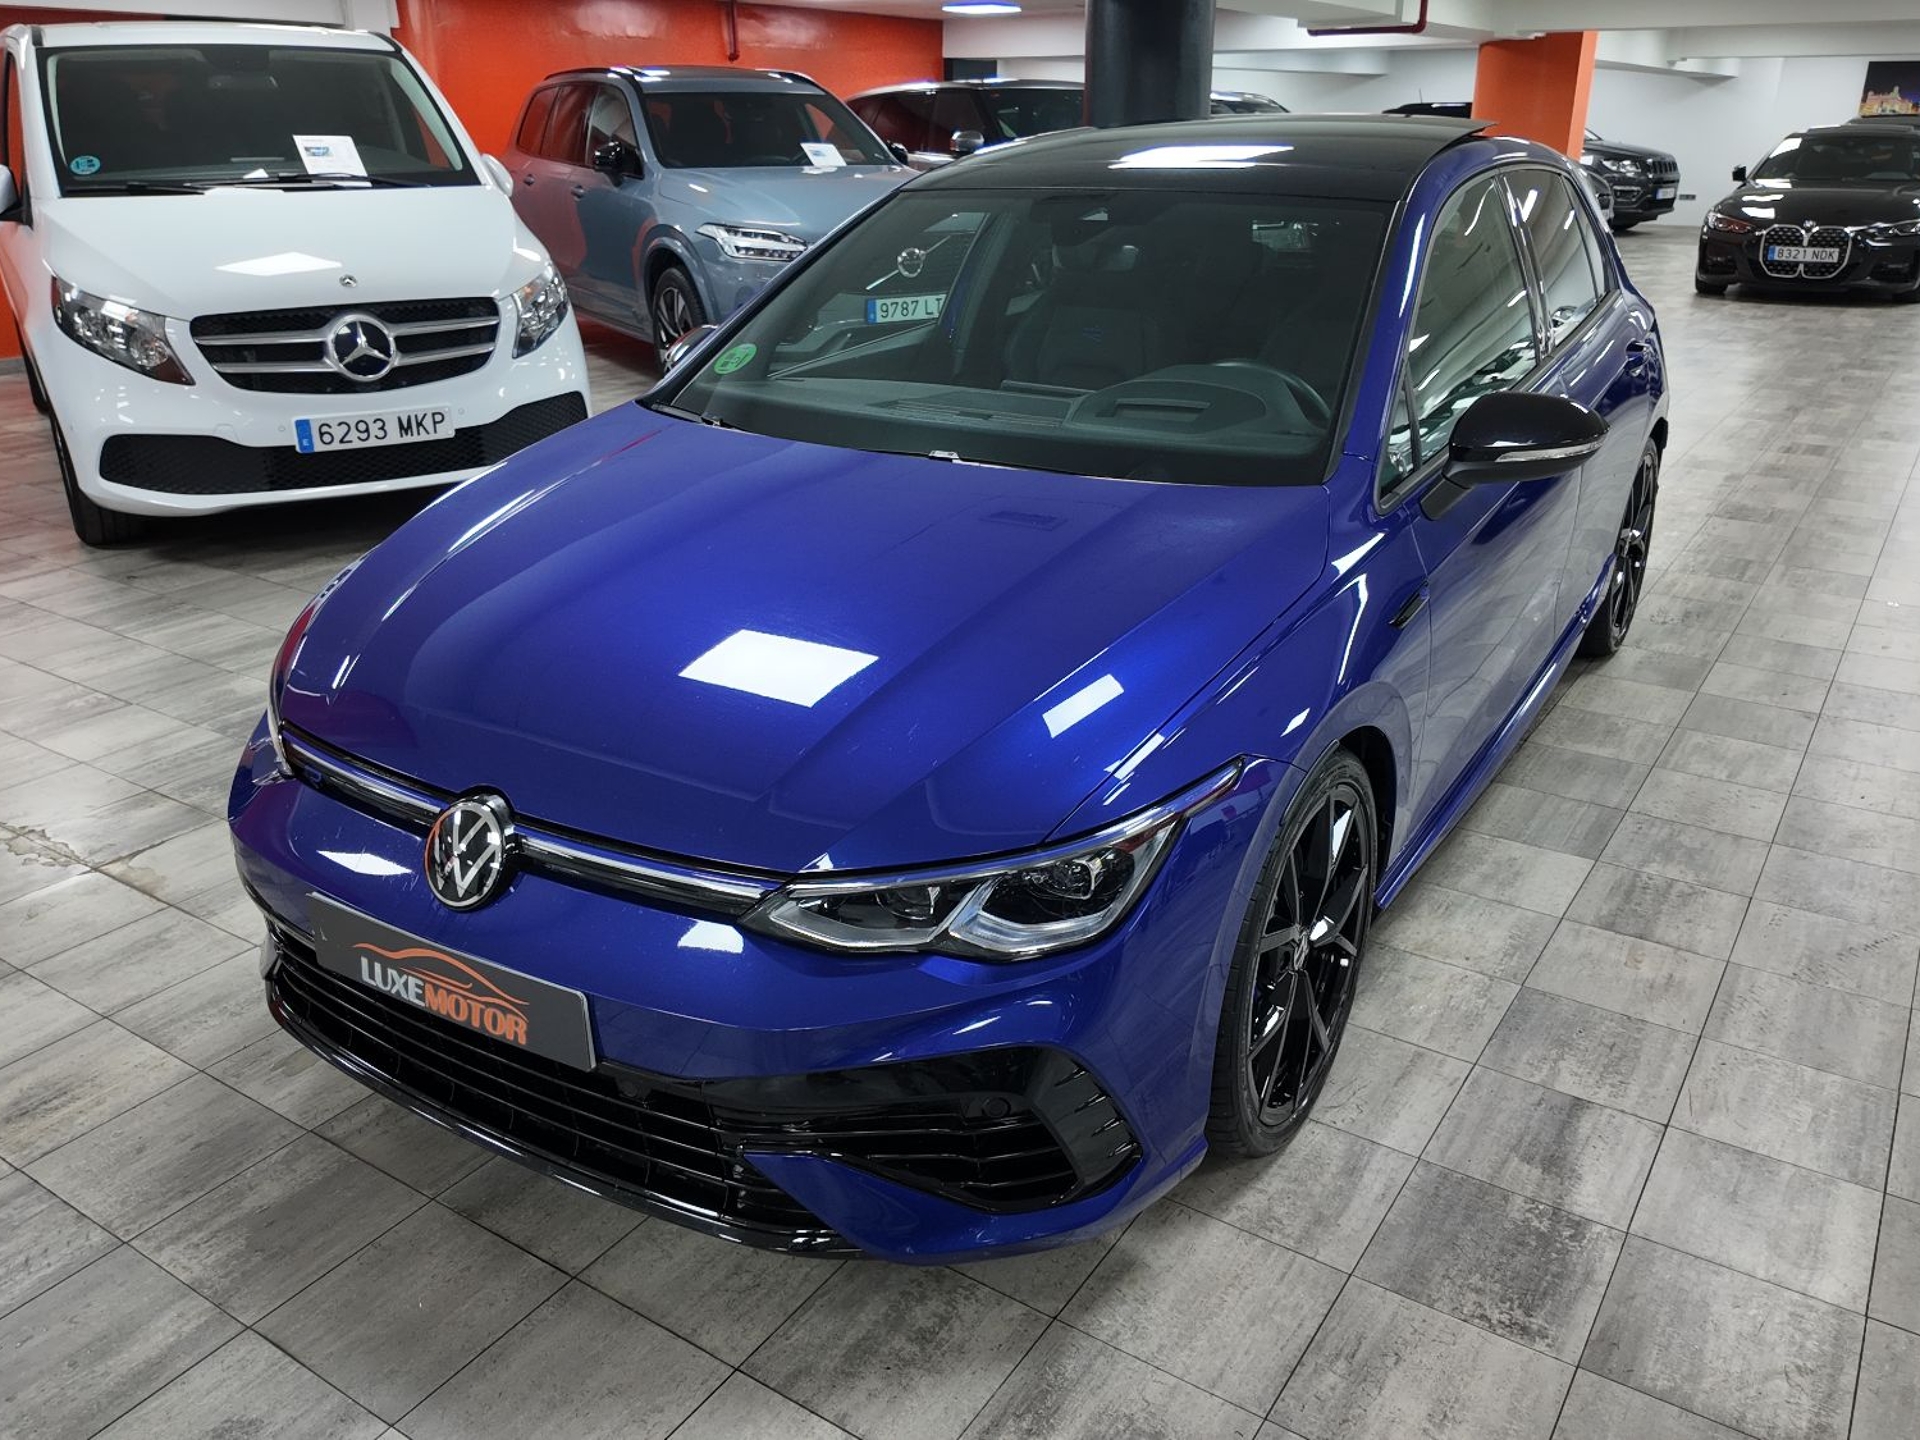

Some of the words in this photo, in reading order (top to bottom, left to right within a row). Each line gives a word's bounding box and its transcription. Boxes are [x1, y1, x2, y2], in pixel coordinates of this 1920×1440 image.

[1777, 248, 1807, 260] 8321
[1811, 249, 1835, 260] NDK
[880, 300, 919, 319] 9787
[317, 417, 388, 446] 6293
[397, 411, 446, 438] MKP
[360, 956, 528, 1046] LUXEMOTOR
